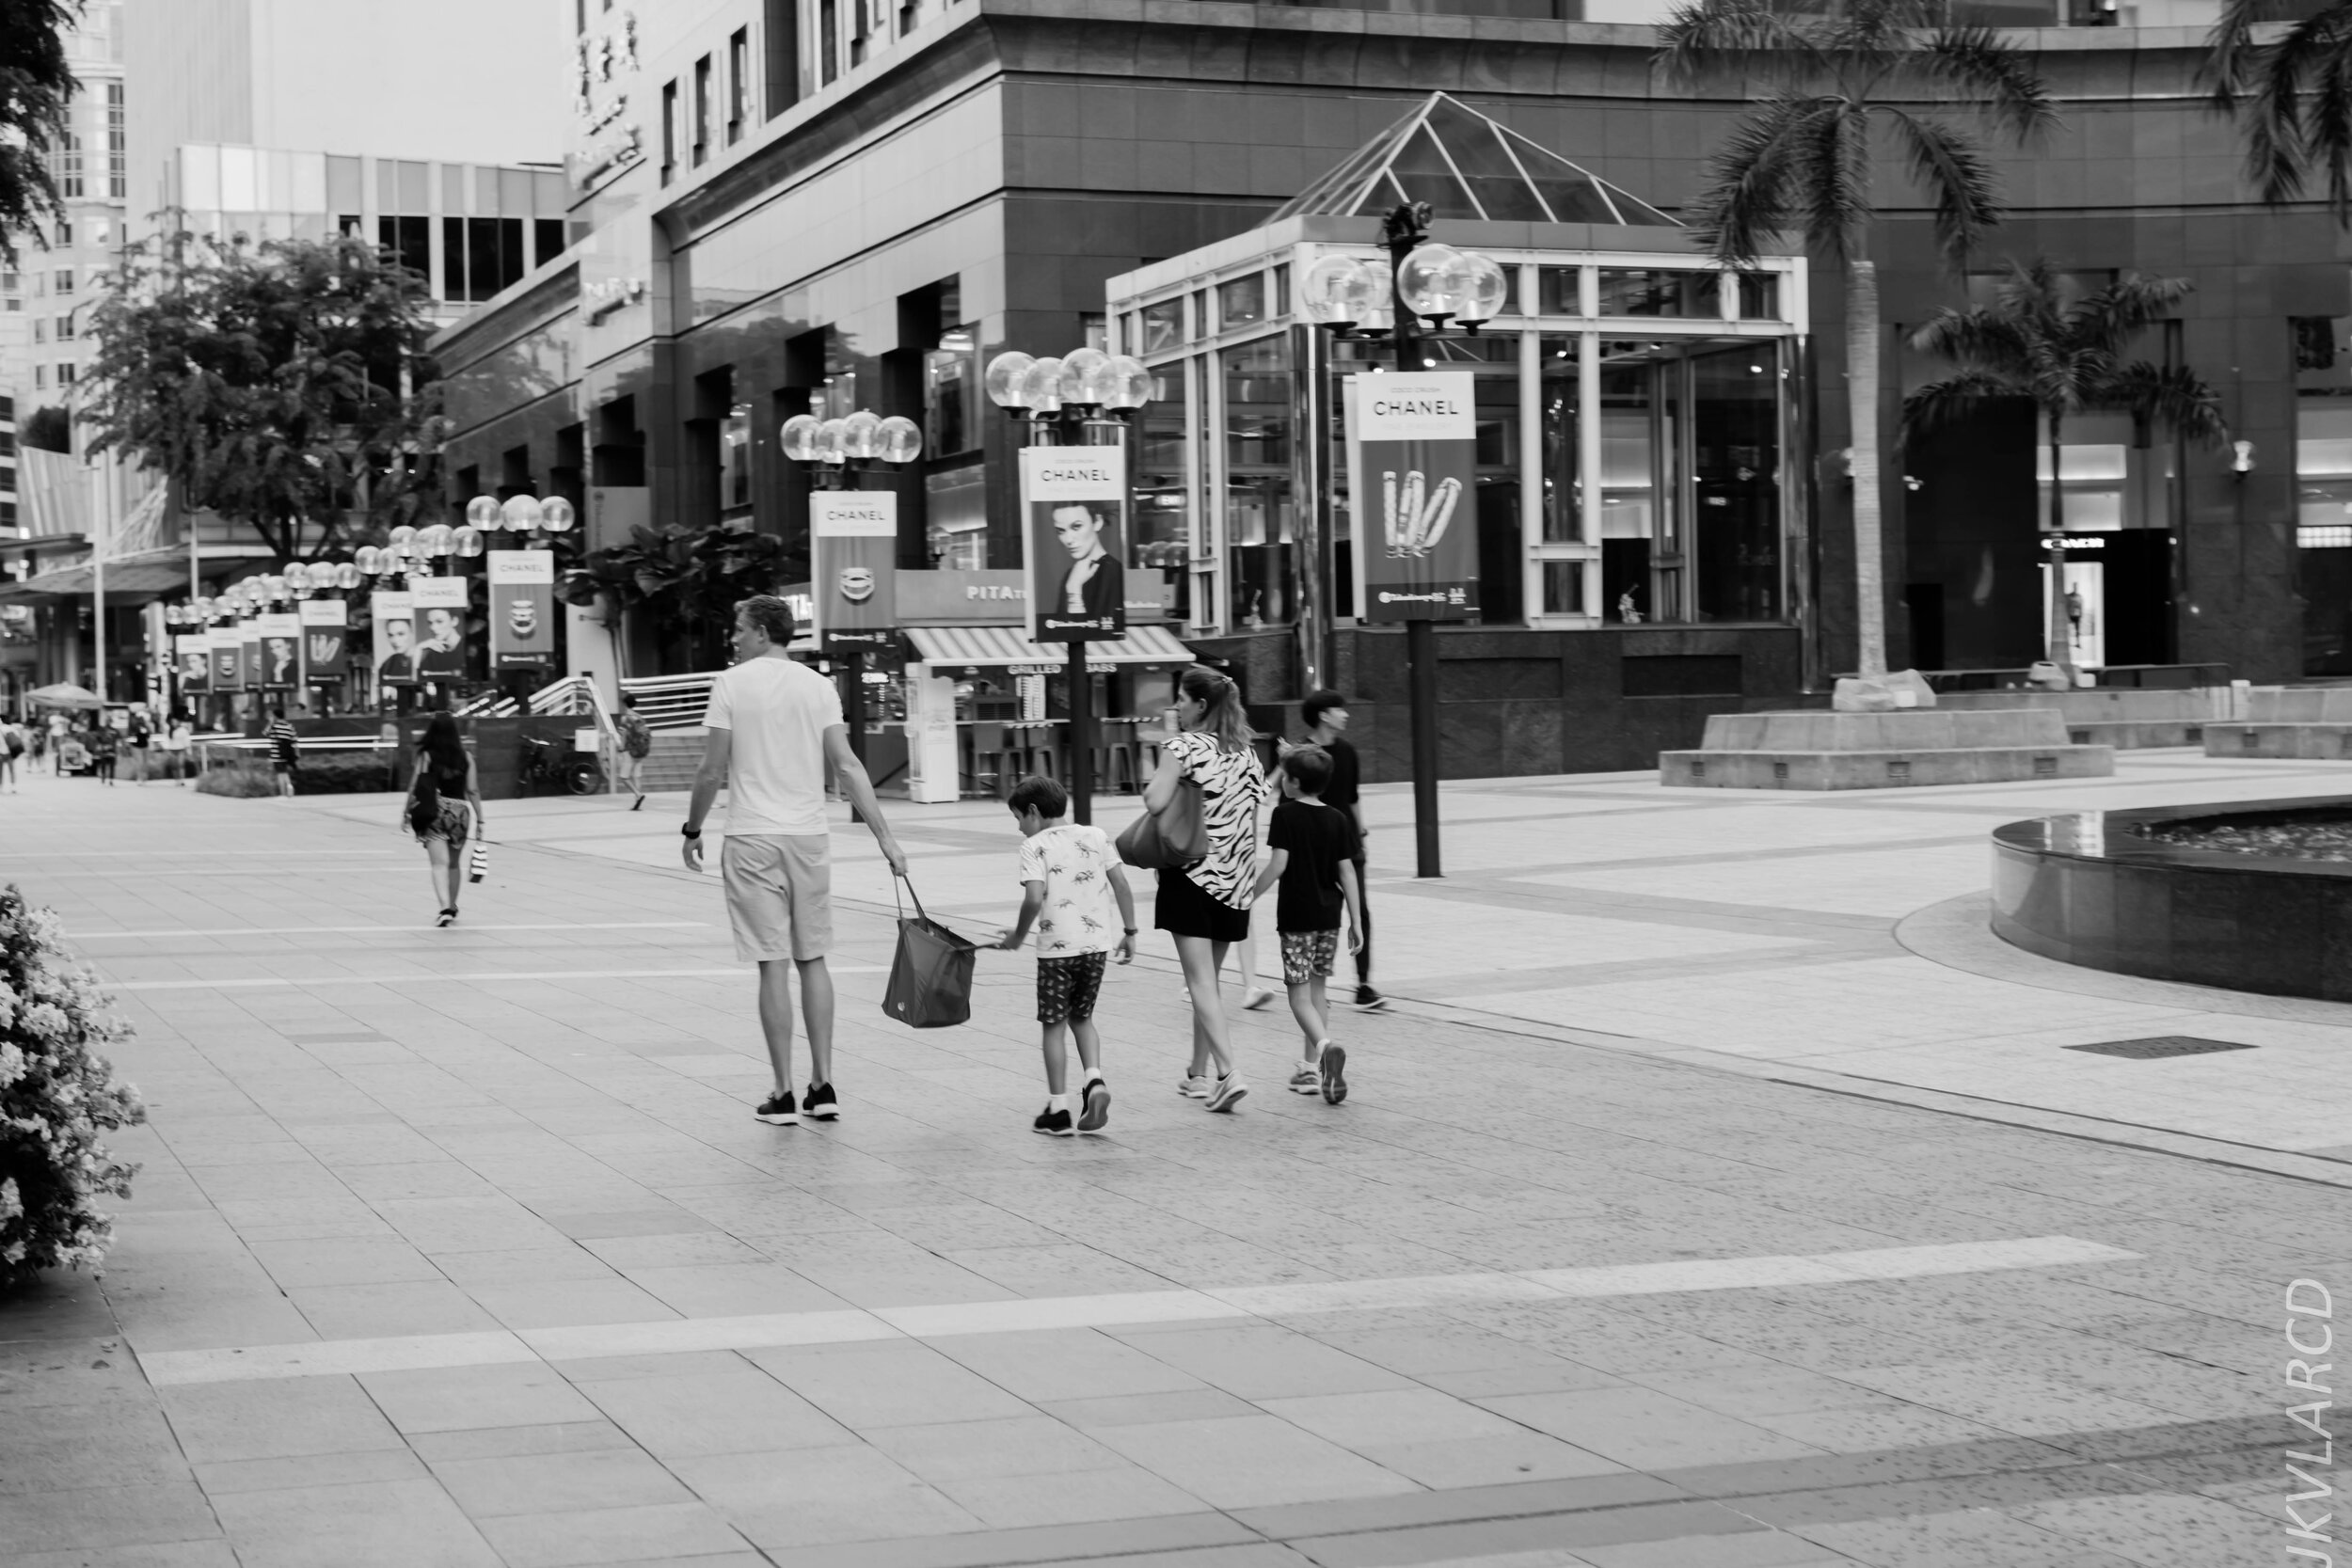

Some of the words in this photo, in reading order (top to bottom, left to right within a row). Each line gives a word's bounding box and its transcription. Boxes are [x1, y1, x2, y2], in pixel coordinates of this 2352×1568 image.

[1374, 401, 1460, 416] CHANEL
[1041, 469, 1111, 482] CHANEL
[827, 511, 886, 521] CHANEL
[499, 564, 545, 573] CHANEL
[1008, 664, 1062, 675] GRILLED
